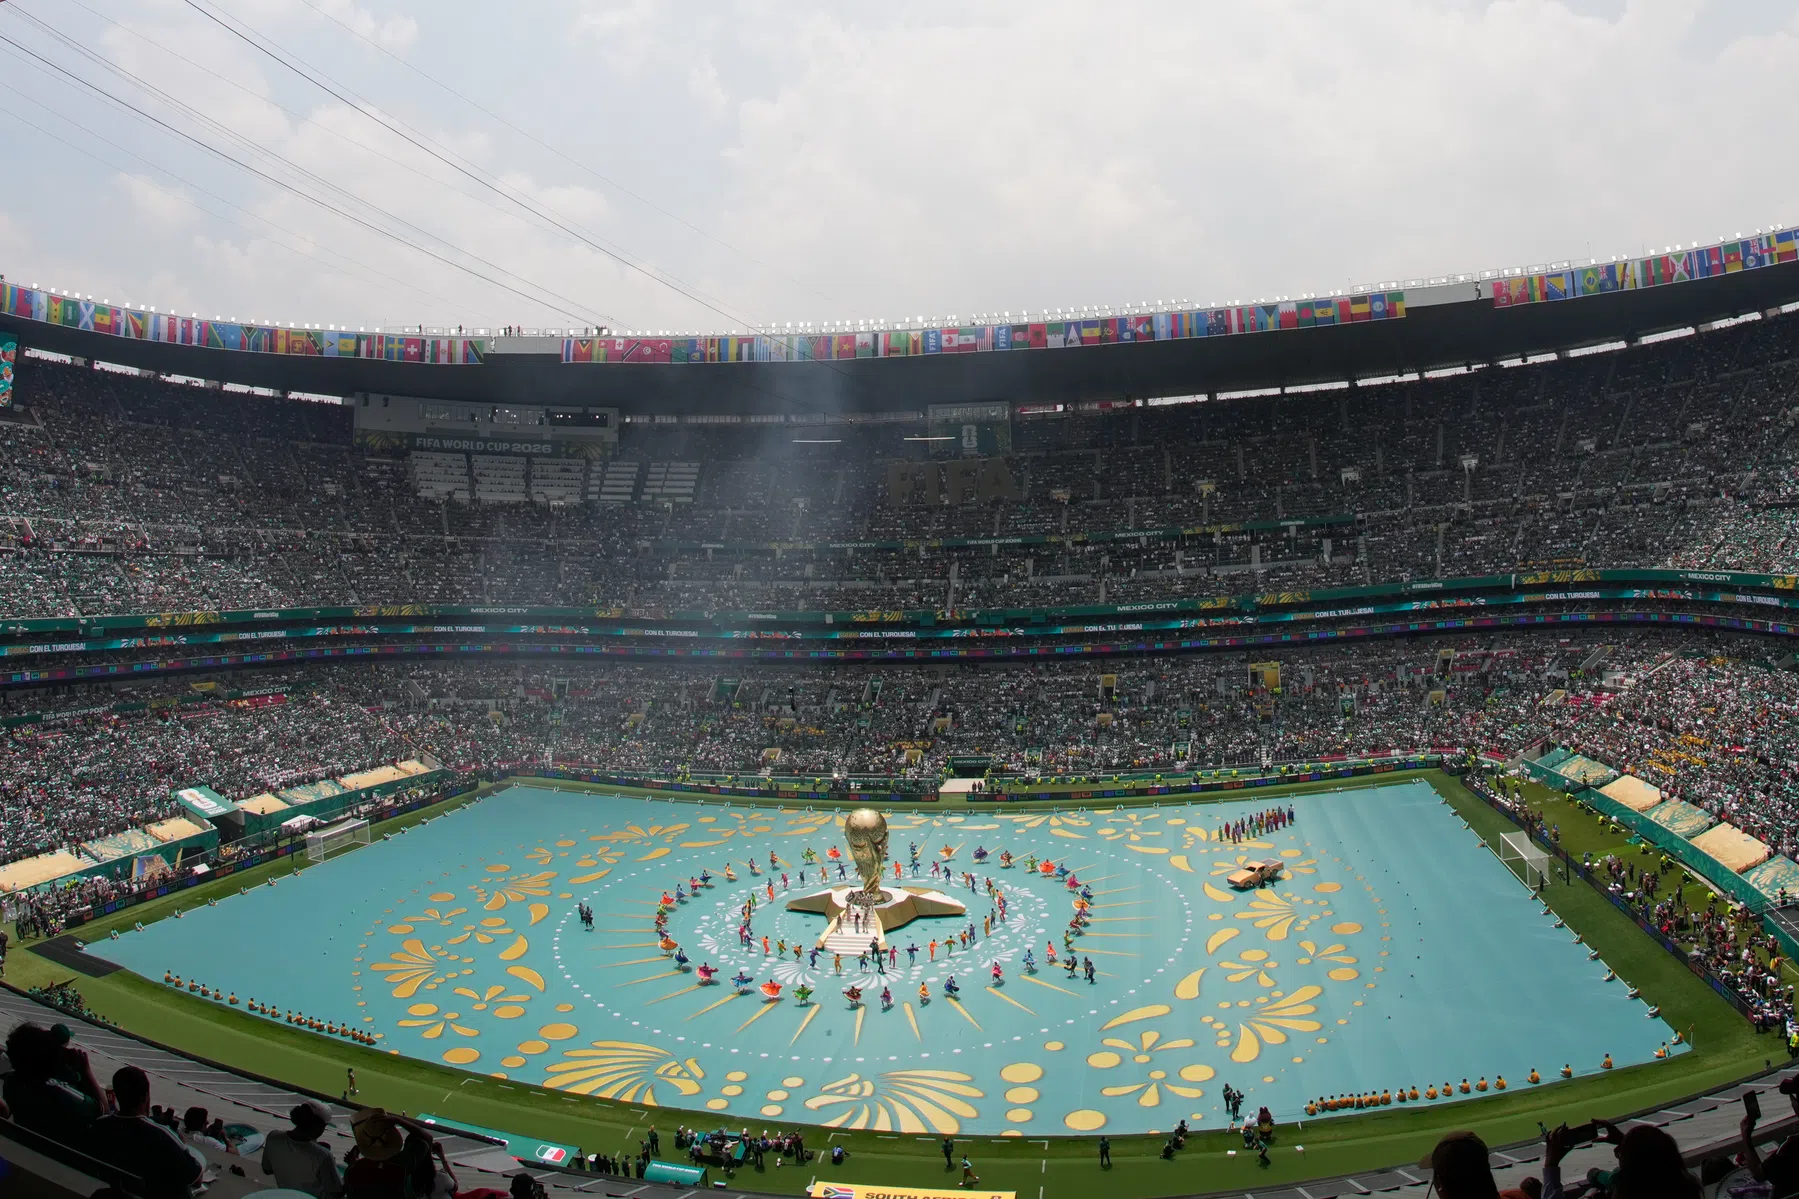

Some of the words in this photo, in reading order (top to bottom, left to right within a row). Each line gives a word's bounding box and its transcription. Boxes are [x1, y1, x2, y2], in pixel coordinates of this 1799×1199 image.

[416, 437, 441, 448] FIFA
[442, 439, 484, 451] WORLD
[486, 441, 510, 452] CUP
[511, 442, 552, 454] 2026
[1688, 572, 1714, 581] MEXICO
[1735, 594, 1747, 602] CON
[1747, 595, 1753, 603] EL
[238, 632, 250, 640] CON
[29, 645, 43, 653] CON
[44, 644, 51, 652] EL
[242, 688, 273, 697] MEXICO
[42, 713, 55, 721] FIFA
